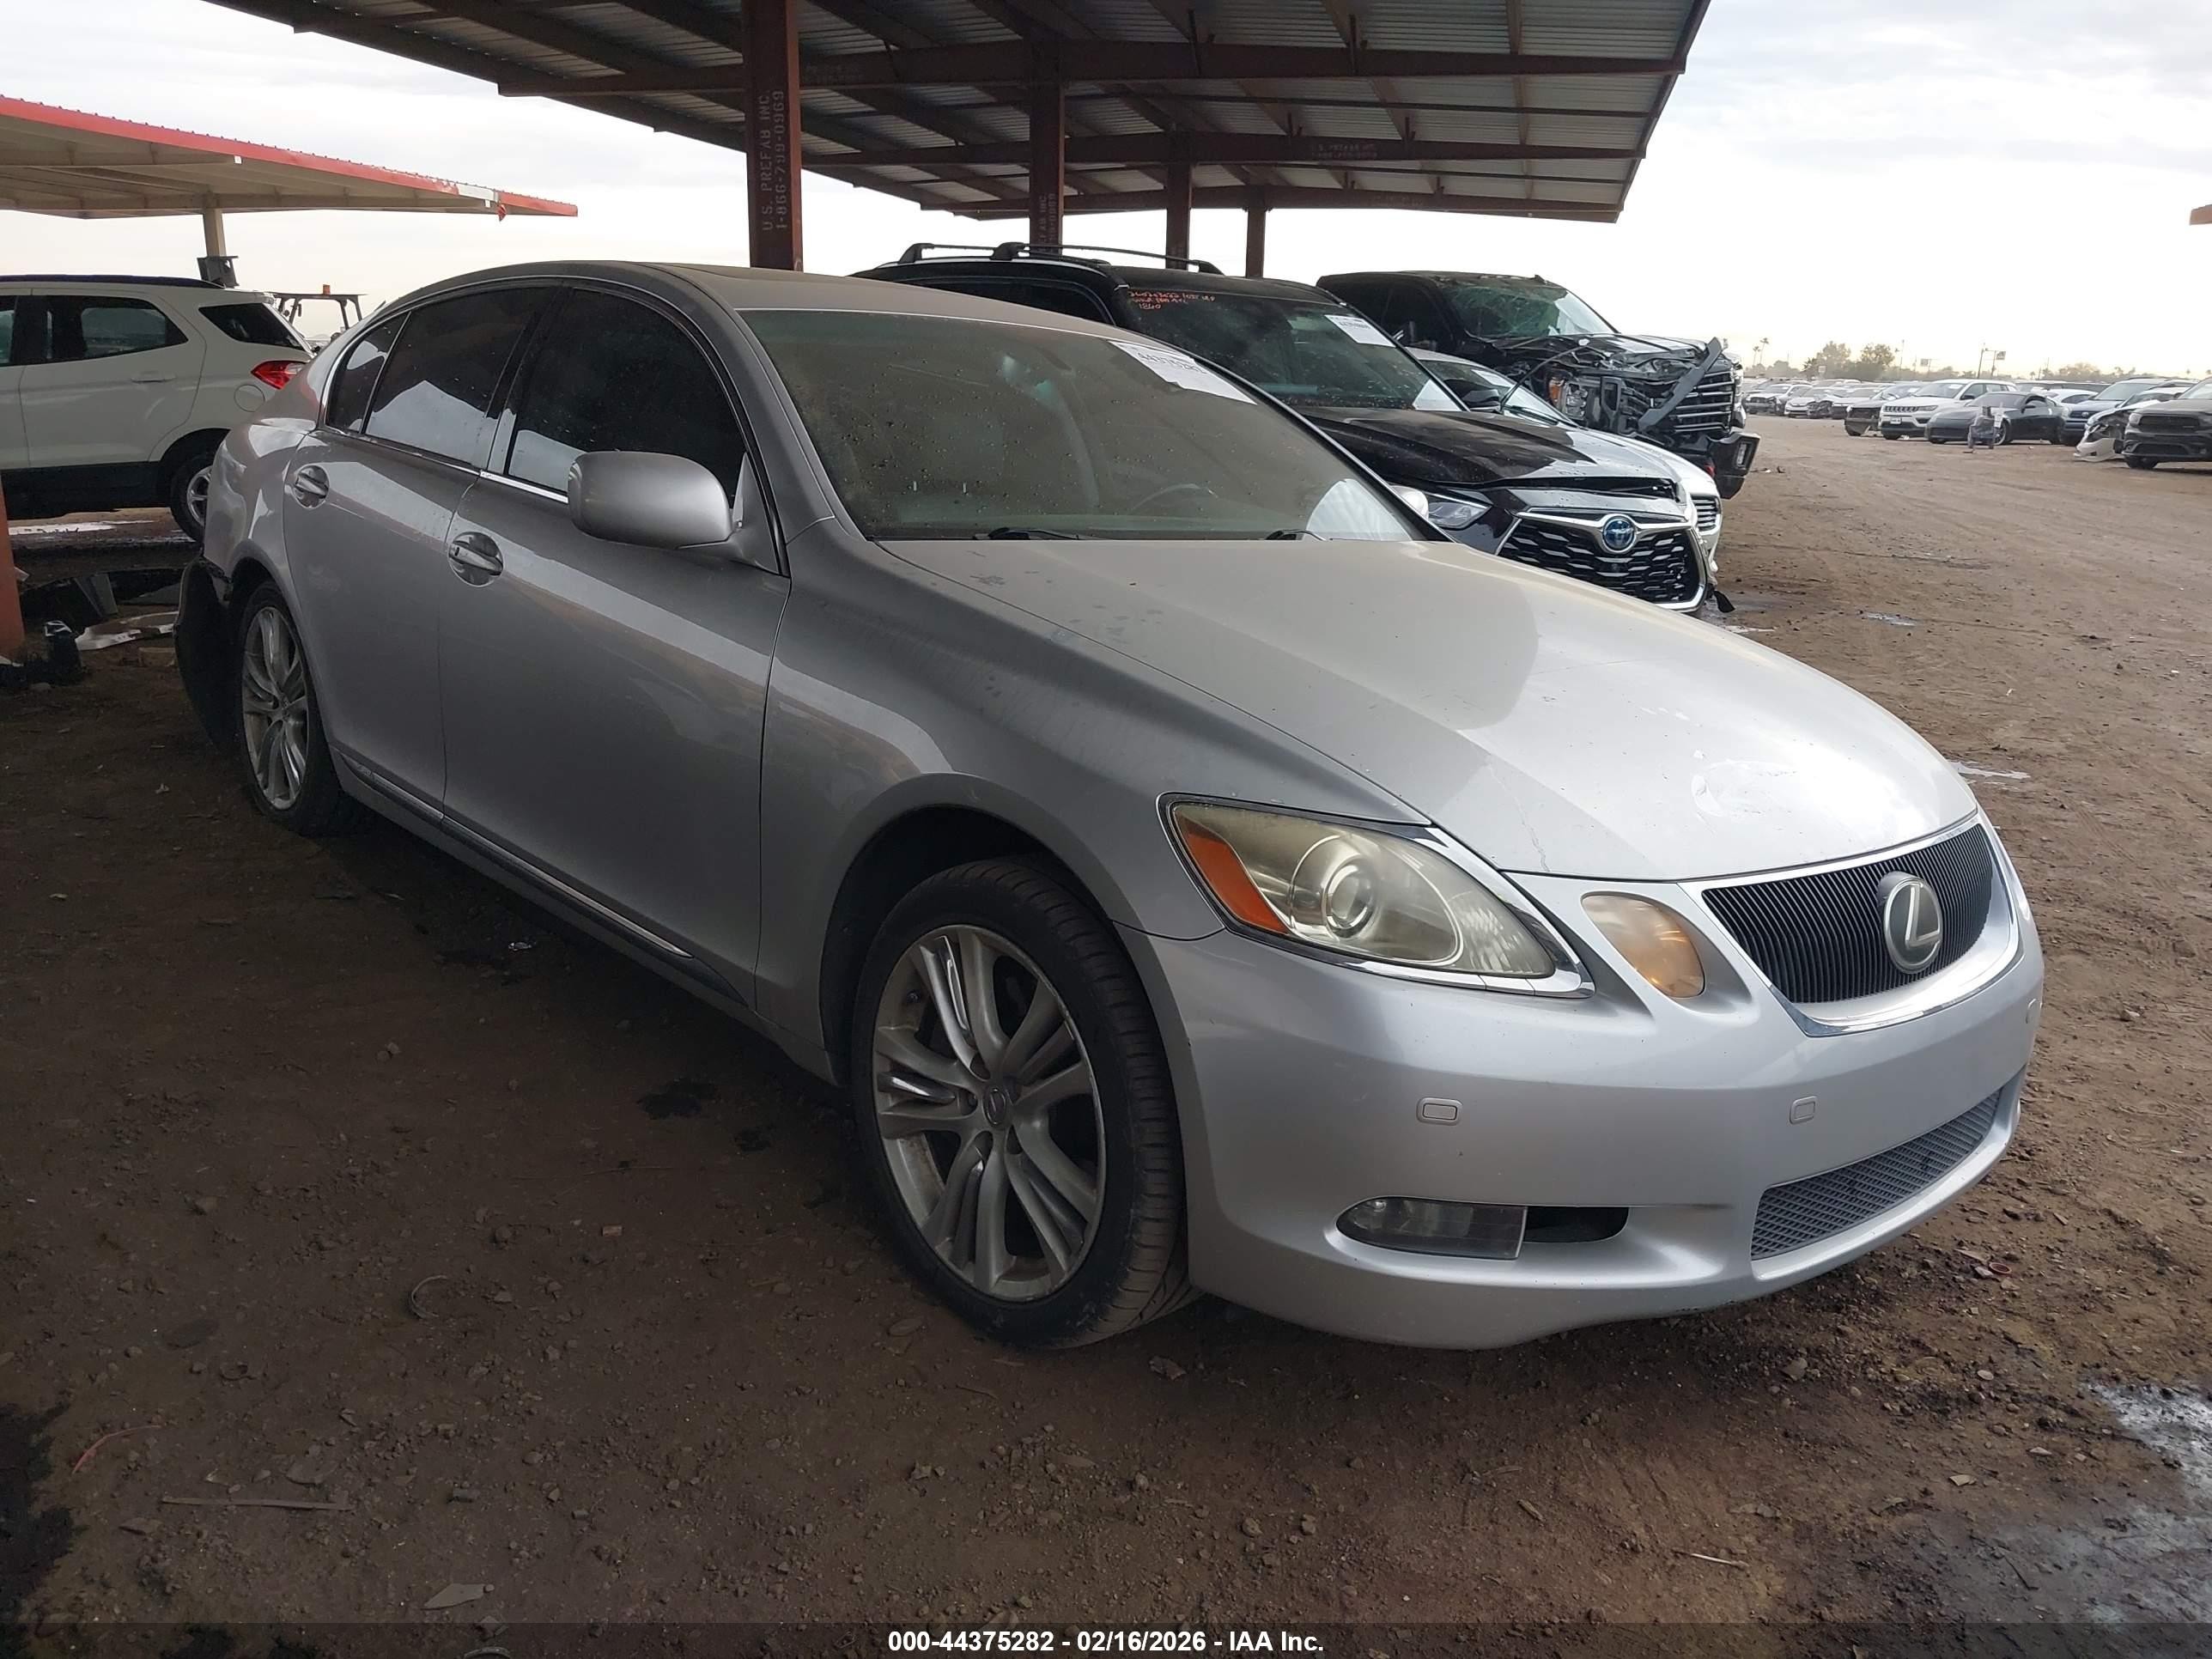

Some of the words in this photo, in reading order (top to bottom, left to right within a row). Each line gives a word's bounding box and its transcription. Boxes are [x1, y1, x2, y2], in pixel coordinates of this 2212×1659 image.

[758, 89, 771, 120] INC.
[759, 130, 773, 191] PREFAB
[761, 200, 774, 231] U.S.
